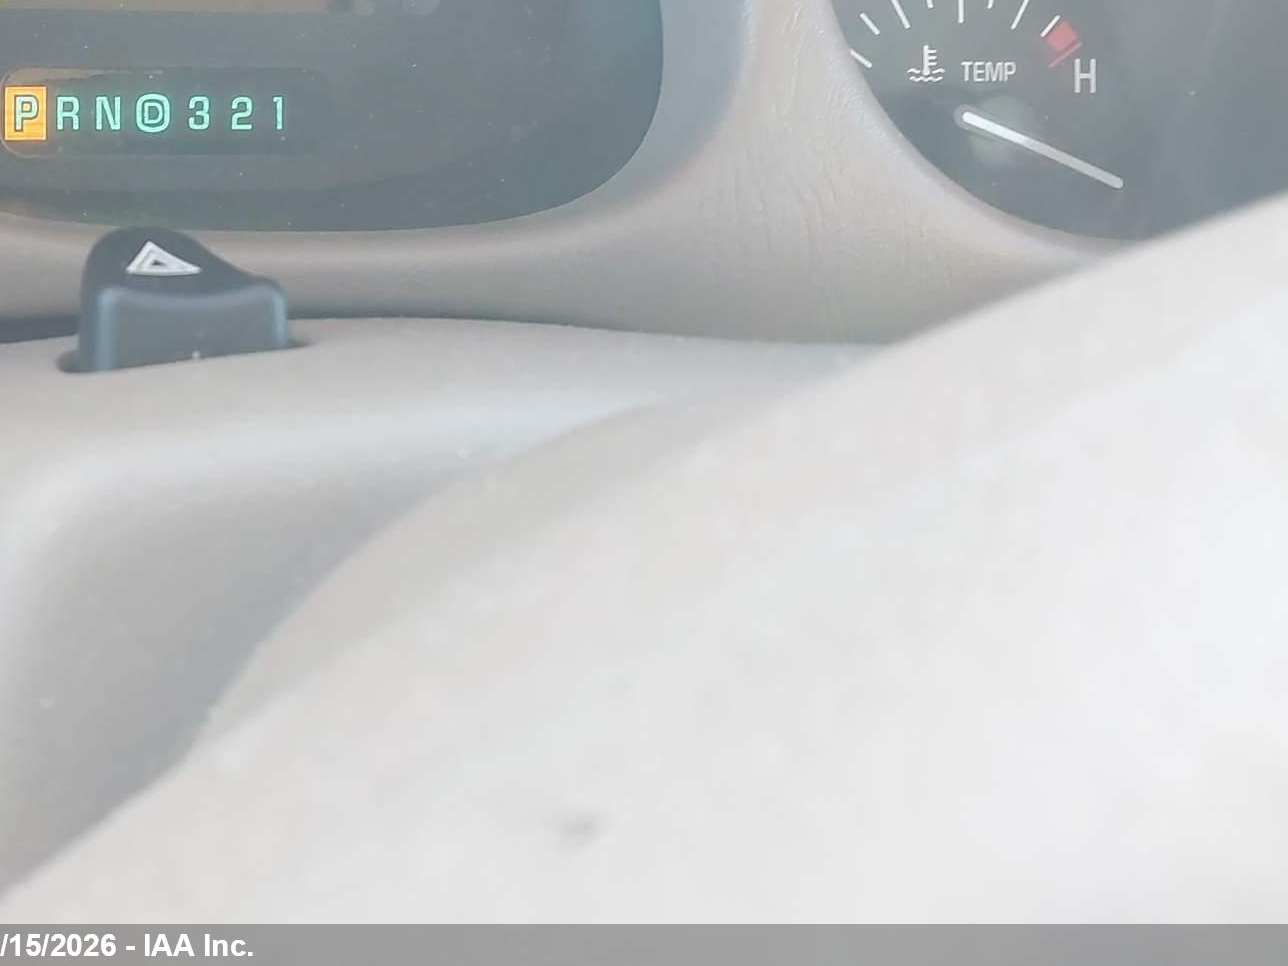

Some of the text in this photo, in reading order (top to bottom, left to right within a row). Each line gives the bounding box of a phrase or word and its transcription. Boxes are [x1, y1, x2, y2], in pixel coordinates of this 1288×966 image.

[960, 61, 1017, 82] TEMP
[1074, 57, 1097, 94] H
[14, 94, 40, 132] P
[56, 96, 80, 131] R
[95, 96, 121, 131] N
[188, 96, 210, 130] 3
[231, 96, 253, 130] 2
[272, 96, 283, 130] 1
